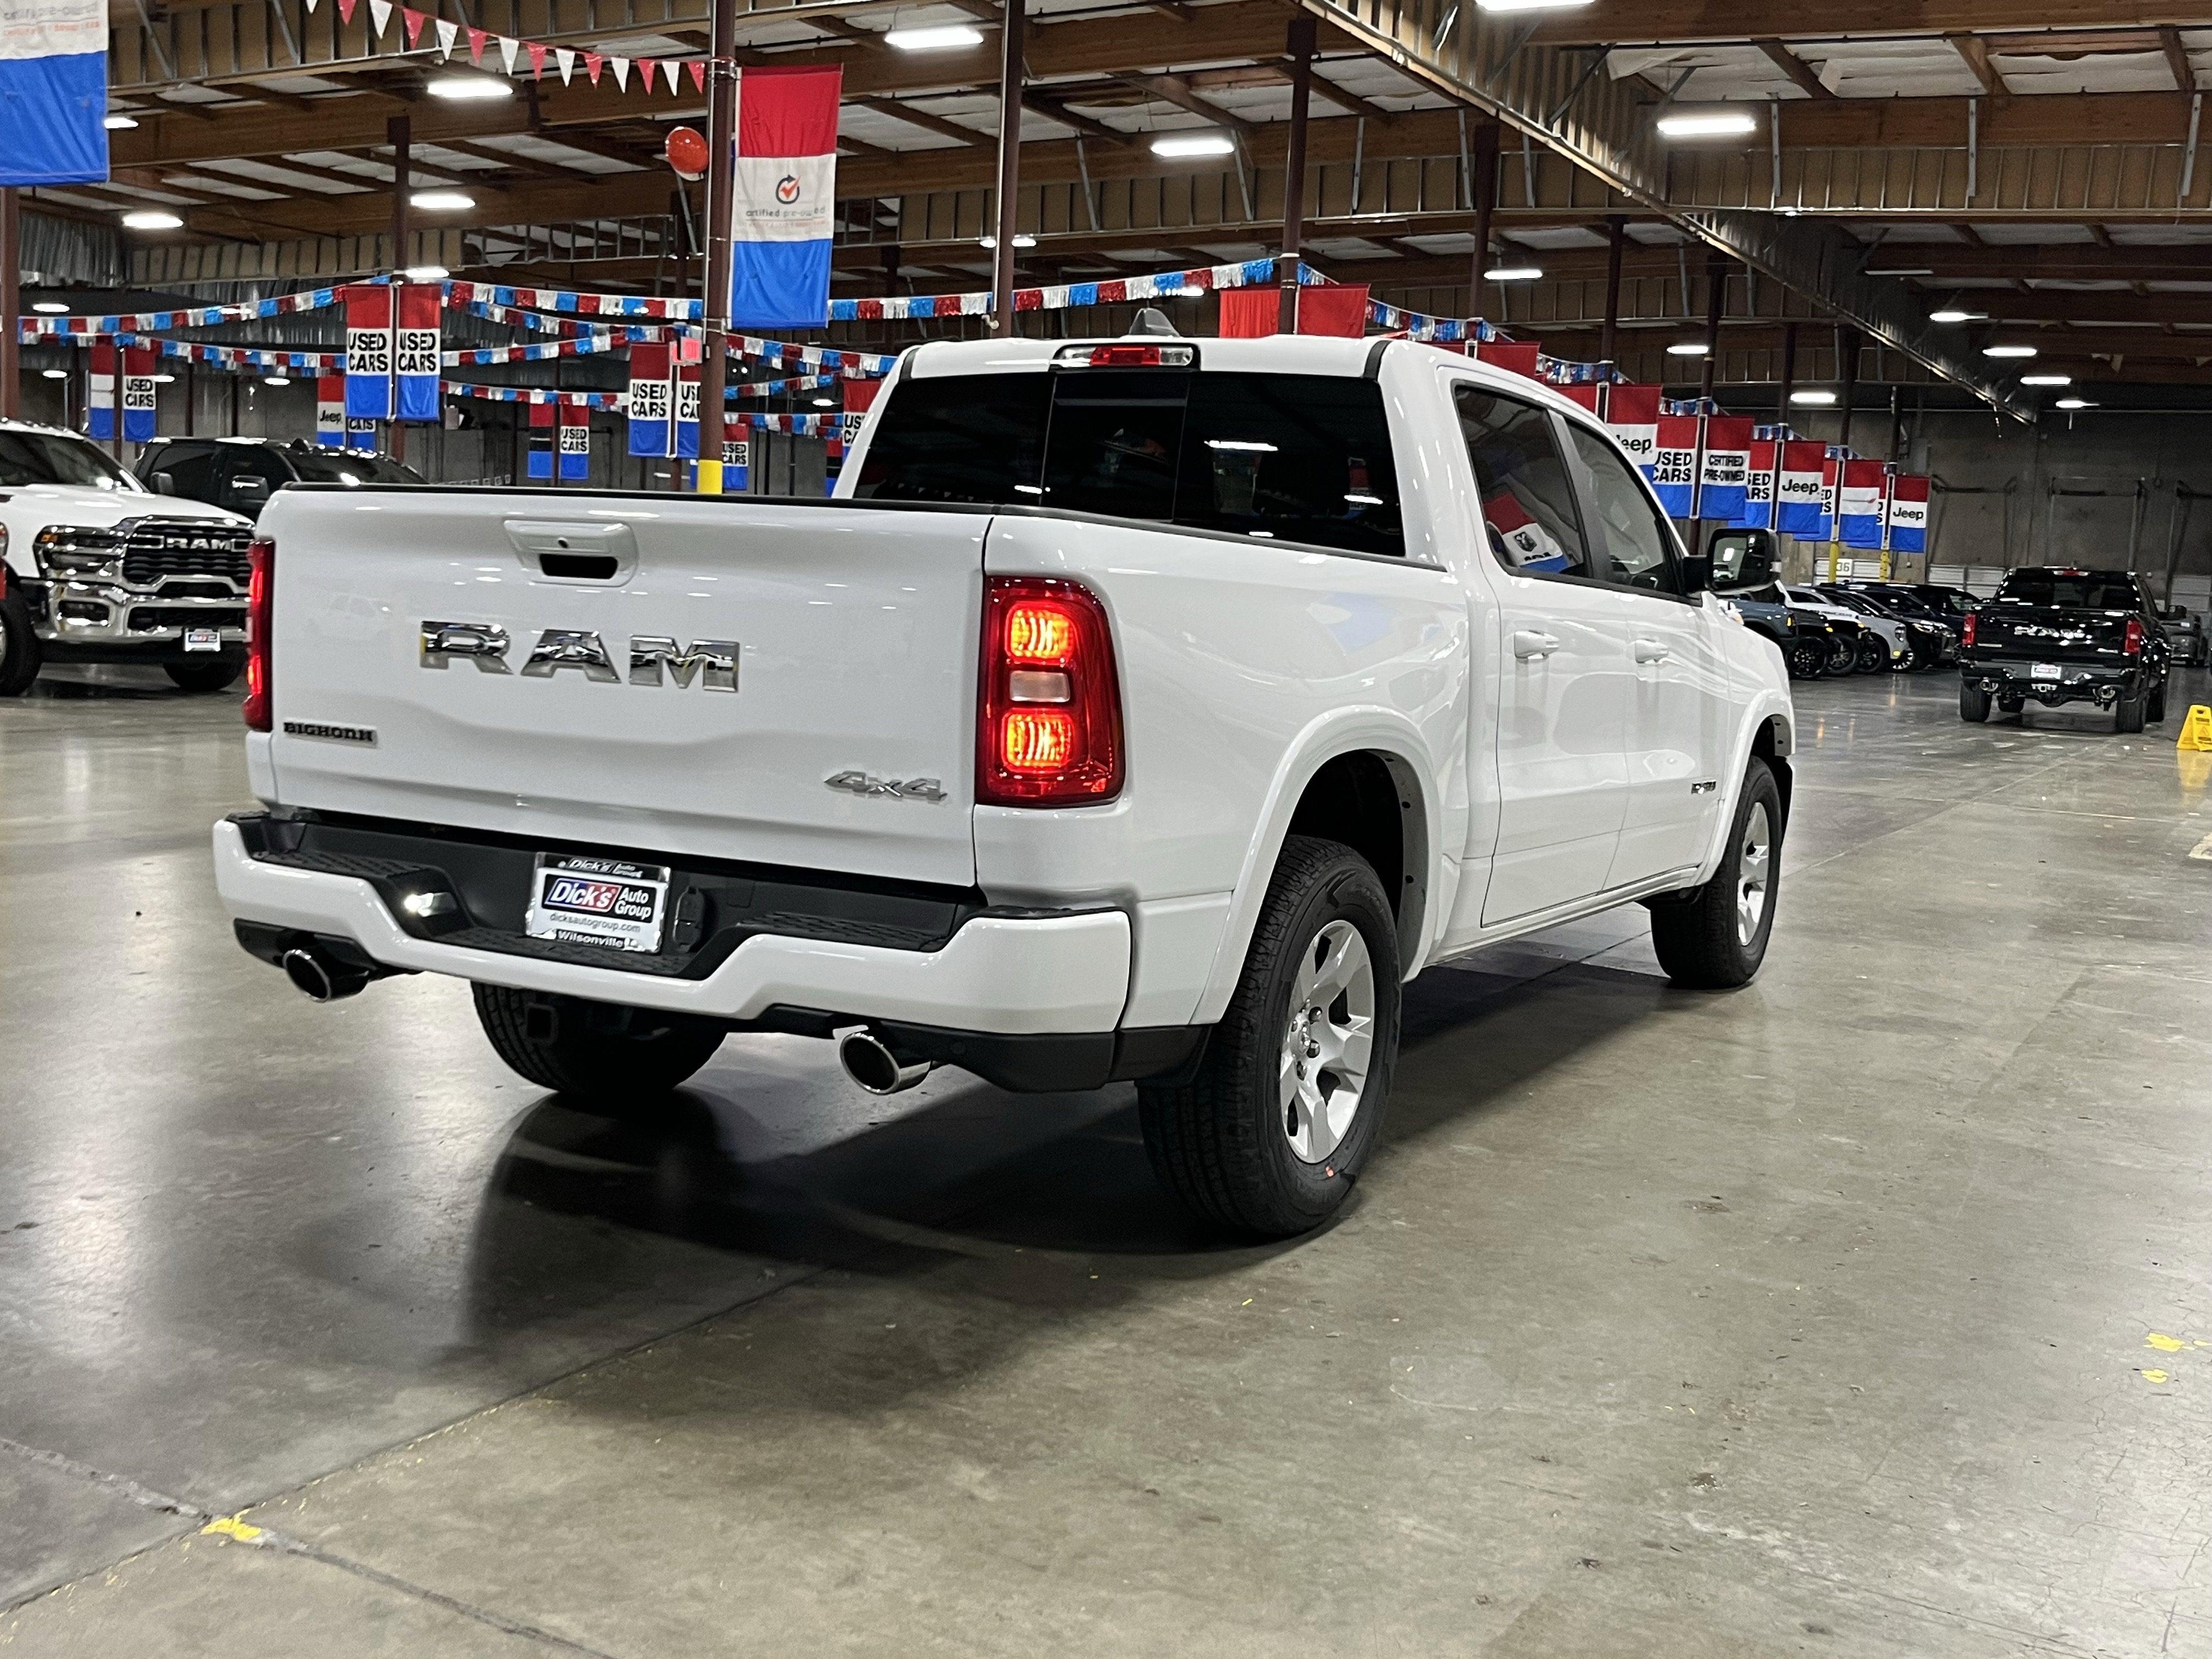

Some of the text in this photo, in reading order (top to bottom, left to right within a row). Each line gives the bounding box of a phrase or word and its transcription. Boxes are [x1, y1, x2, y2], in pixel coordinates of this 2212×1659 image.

[348, 332, 387, 351] USED
[399, 332, 436, 351] USED
[348, 353, 388, 372] CARS
[398, 353, 437, 372] CARS
[126, 379, 153, 392] USED
[633, 383, 667, 399] USED
[681, 385, 701, 400] US
[631, 400, 667, 417] CARS
[680, 402, 700, 419] CA
[844, 414, 866, 430] US
[561, 428, 587, 440] USED
[561, 441, 588, 452] CARS
[723, 443, 746, 454] USED
[723, 454, 747, 465] CARS
[1653, 468, 1691, 482] CARS
[1748, 473, 1771, 486] ED
[1747, 487, 1770, 500] RS
[1782, 479, 1819, 495] Jeep
[1893, 507, 1924, 521] Jeep
[166, 538, 231, 550] RAM
[419, 620, 741, 694] RAM
[550, 882, 614, 907] Dick's
[618, 887, 649, 904] Auto
[614, 900, 652, 921] Group
[550, 912, 641, 932] dicksautogroup.com
[557, 930, 624, 948] Wilsonville
